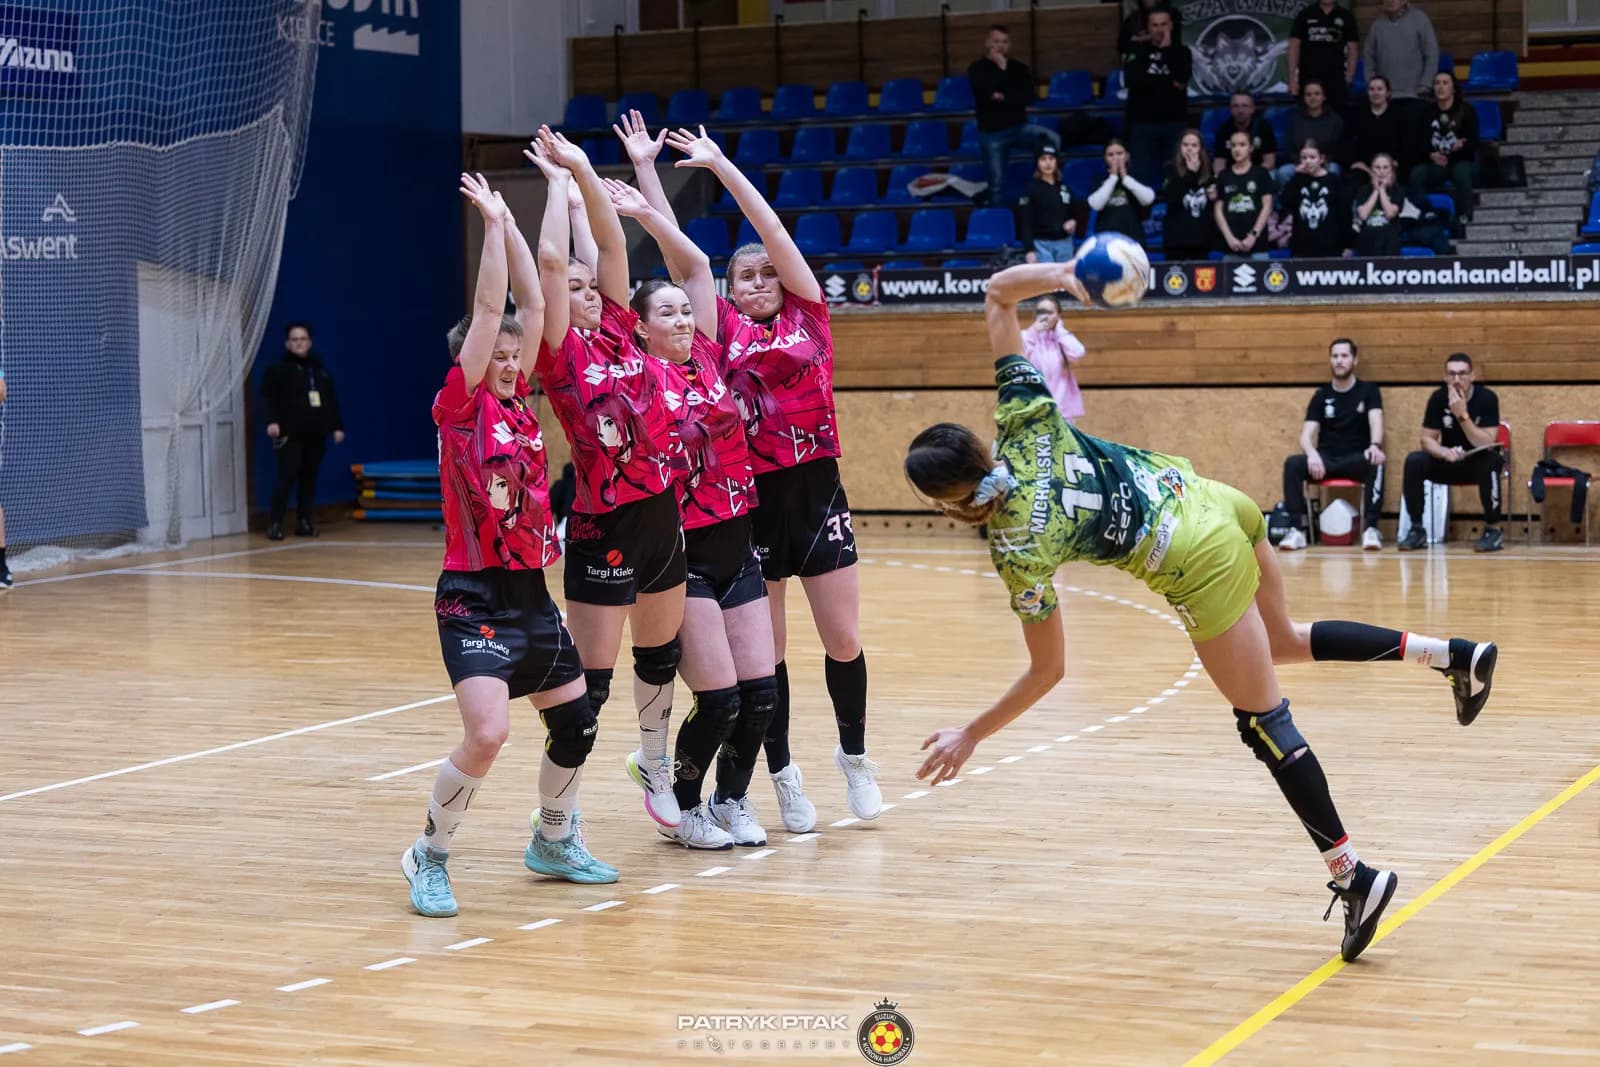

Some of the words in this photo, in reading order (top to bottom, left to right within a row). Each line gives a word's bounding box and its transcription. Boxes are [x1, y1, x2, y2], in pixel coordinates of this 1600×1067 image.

[1296, 260, 1600, 289] www.koronahandball.pl
[1029, 433, 1052, 534] MICHALSKA
[586, 565, 611, 579] Targi
[461, 638, 486, 648] Targi
